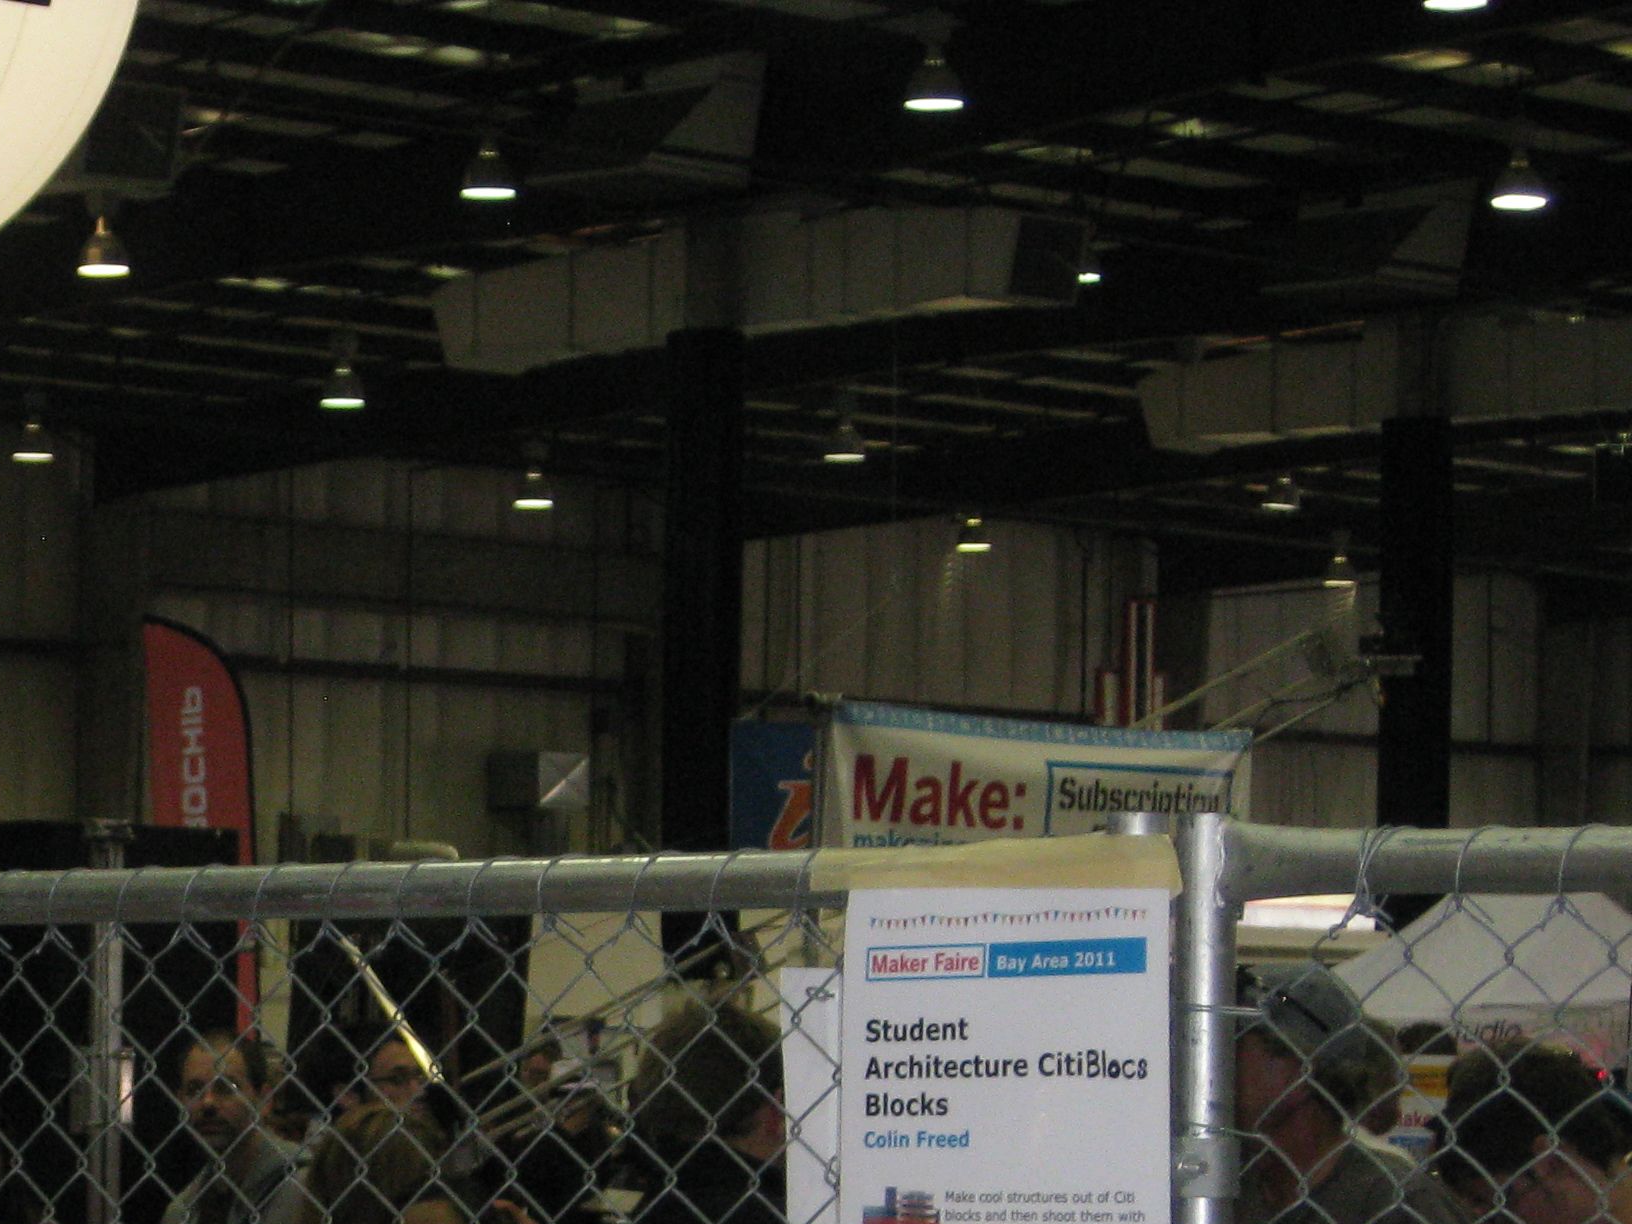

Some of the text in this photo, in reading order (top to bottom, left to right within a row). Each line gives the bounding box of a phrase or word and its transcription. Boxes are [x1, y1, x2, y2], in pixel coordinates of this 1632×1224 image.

[852, 754, 1027, 830] Make:
[872, 952, 979, 974] Maker Faire
[996, 951, 1117, 972] Bay Area 2011
[866, 1017, 969, 1042] Student
[865, 1056, 1029, 1080] Architecture
[865, 1094, 949, 1117] Blocks
[864, 1130, 970, 1149] Colin Freed
[945, 1191, 1136, 1204] Make cool structures out of Citi
[945, 1210, 1146, 1223] blocks and then shoot them with
